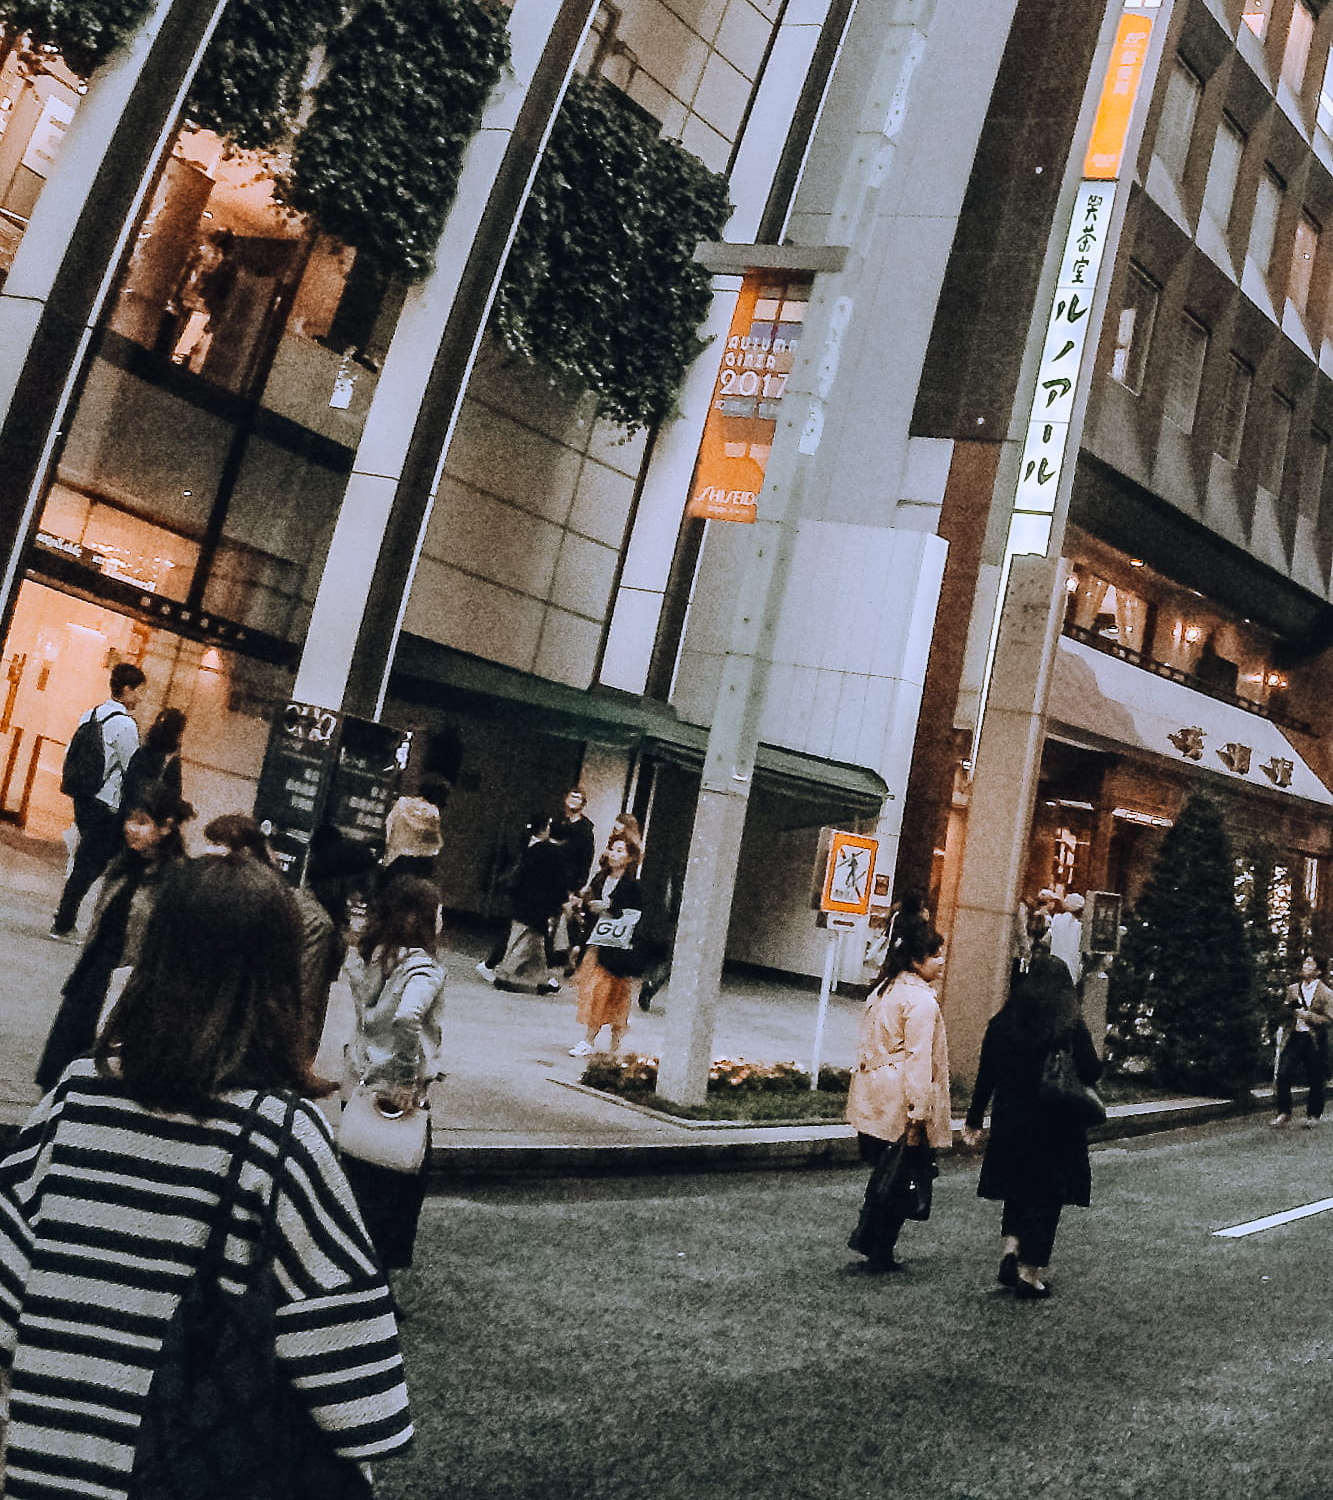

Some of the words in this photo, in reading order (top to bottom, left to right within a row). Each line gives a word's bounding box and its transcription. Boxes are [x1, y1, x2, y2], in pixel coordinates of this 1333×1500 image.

[1071, 194, 1103, 285] 喫茶室
[720, 369, 789, 396] 2017
[1023, 293, 1089, 486] ルノアール
[697, 485, 757, 506] SHISEID
[597, 922, 627, 939] GU
